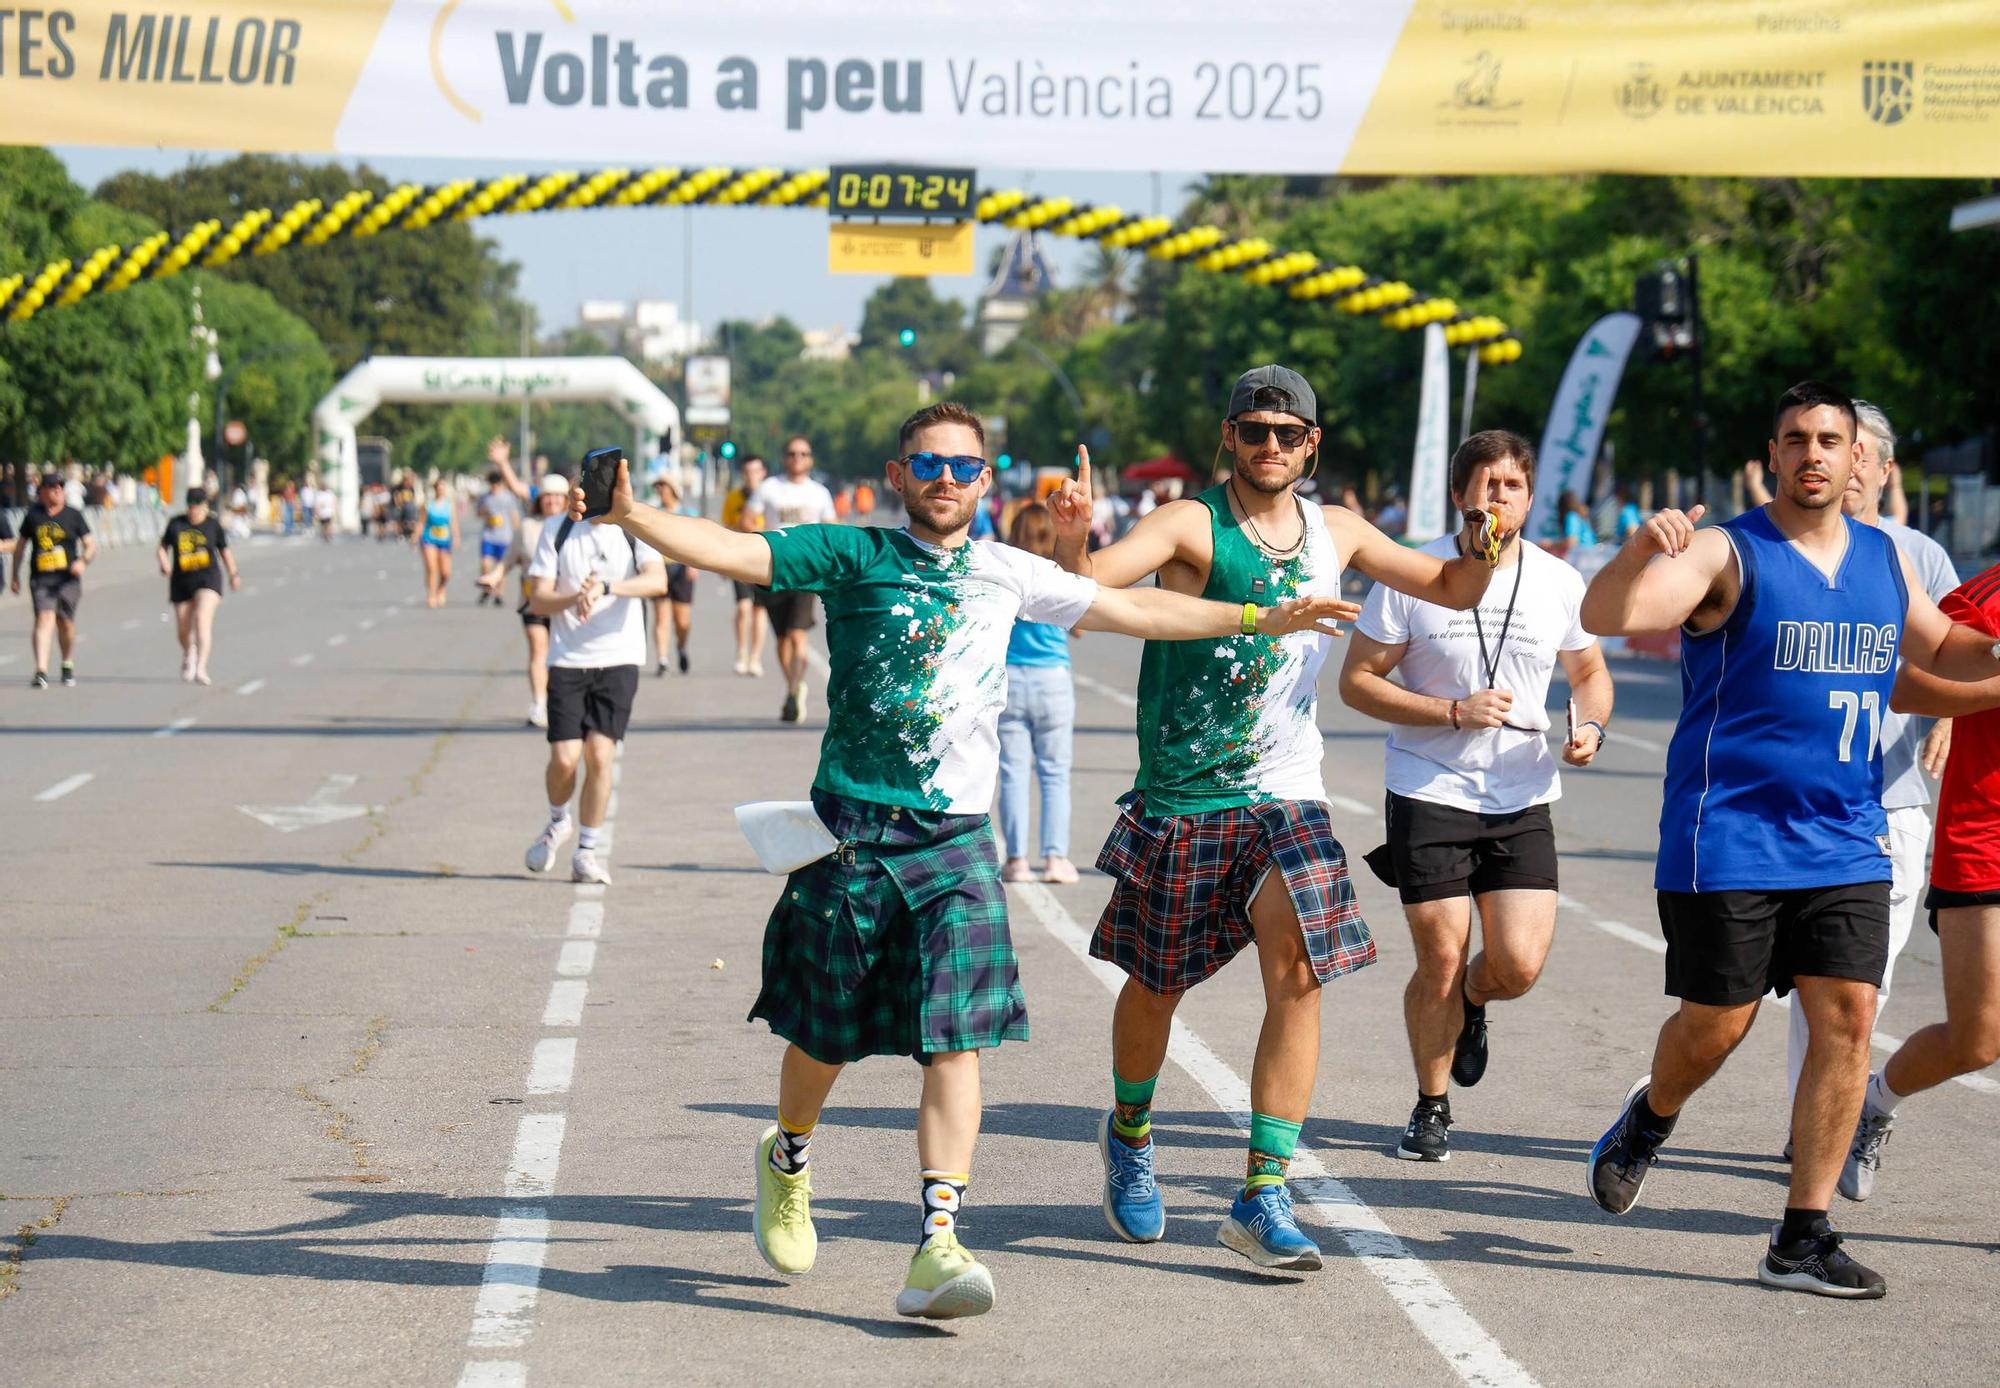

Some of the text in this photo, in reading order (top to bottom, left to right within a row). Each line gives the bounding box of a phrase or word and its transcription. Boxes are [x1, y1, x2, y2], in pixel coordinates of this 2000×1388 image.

[99, 12, 302, 86] MILLOR
[495, 31, 1323, 131] Volta a peu València 2025
[1677, 70, 1826, 89] AJUNTAMENT
[1675, 94, 1706, 115] DE
[837, 173, 969, 209] 0:07:24
[1428, 632, 1438, 640] es
[1439, 629, 1450, 639] el
[1449, 631, 1466, 640] que
[1774, 621, 1897, 674] DALLAS
